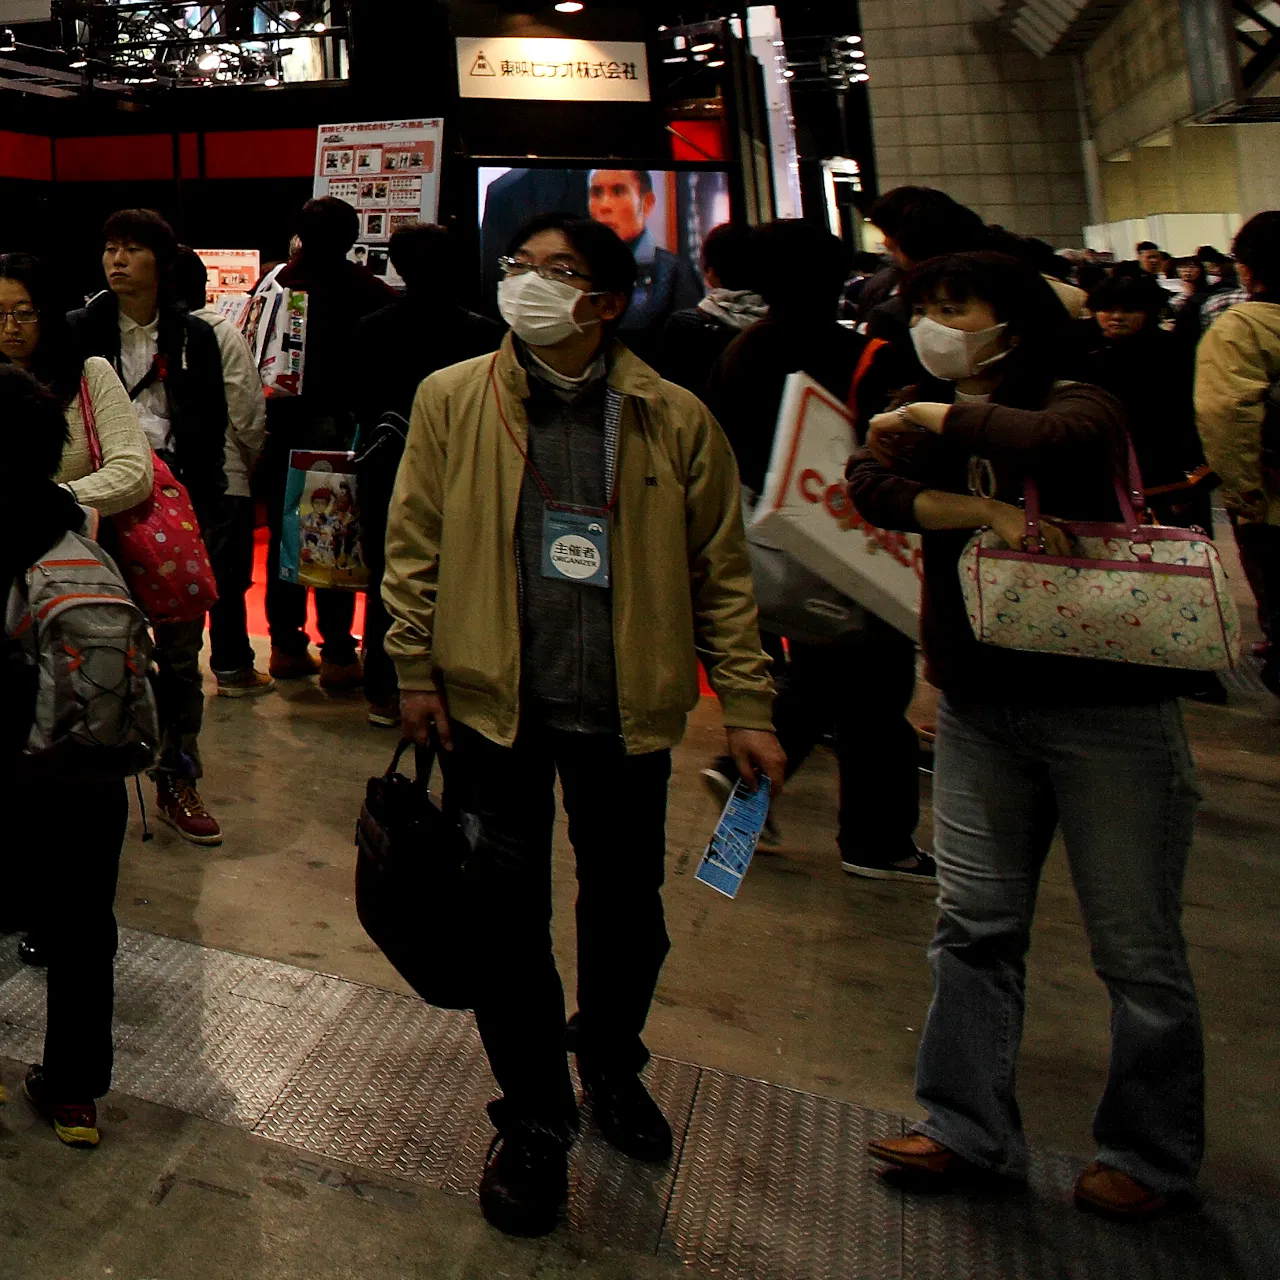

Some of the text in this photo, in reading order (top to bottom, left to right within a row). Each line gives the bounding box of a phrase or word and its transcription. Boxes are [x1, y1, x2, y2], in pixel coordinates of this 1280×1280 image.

[554, 541, 597, 559] 主催者
[552, 555, 598, 568] ORGANIZER
